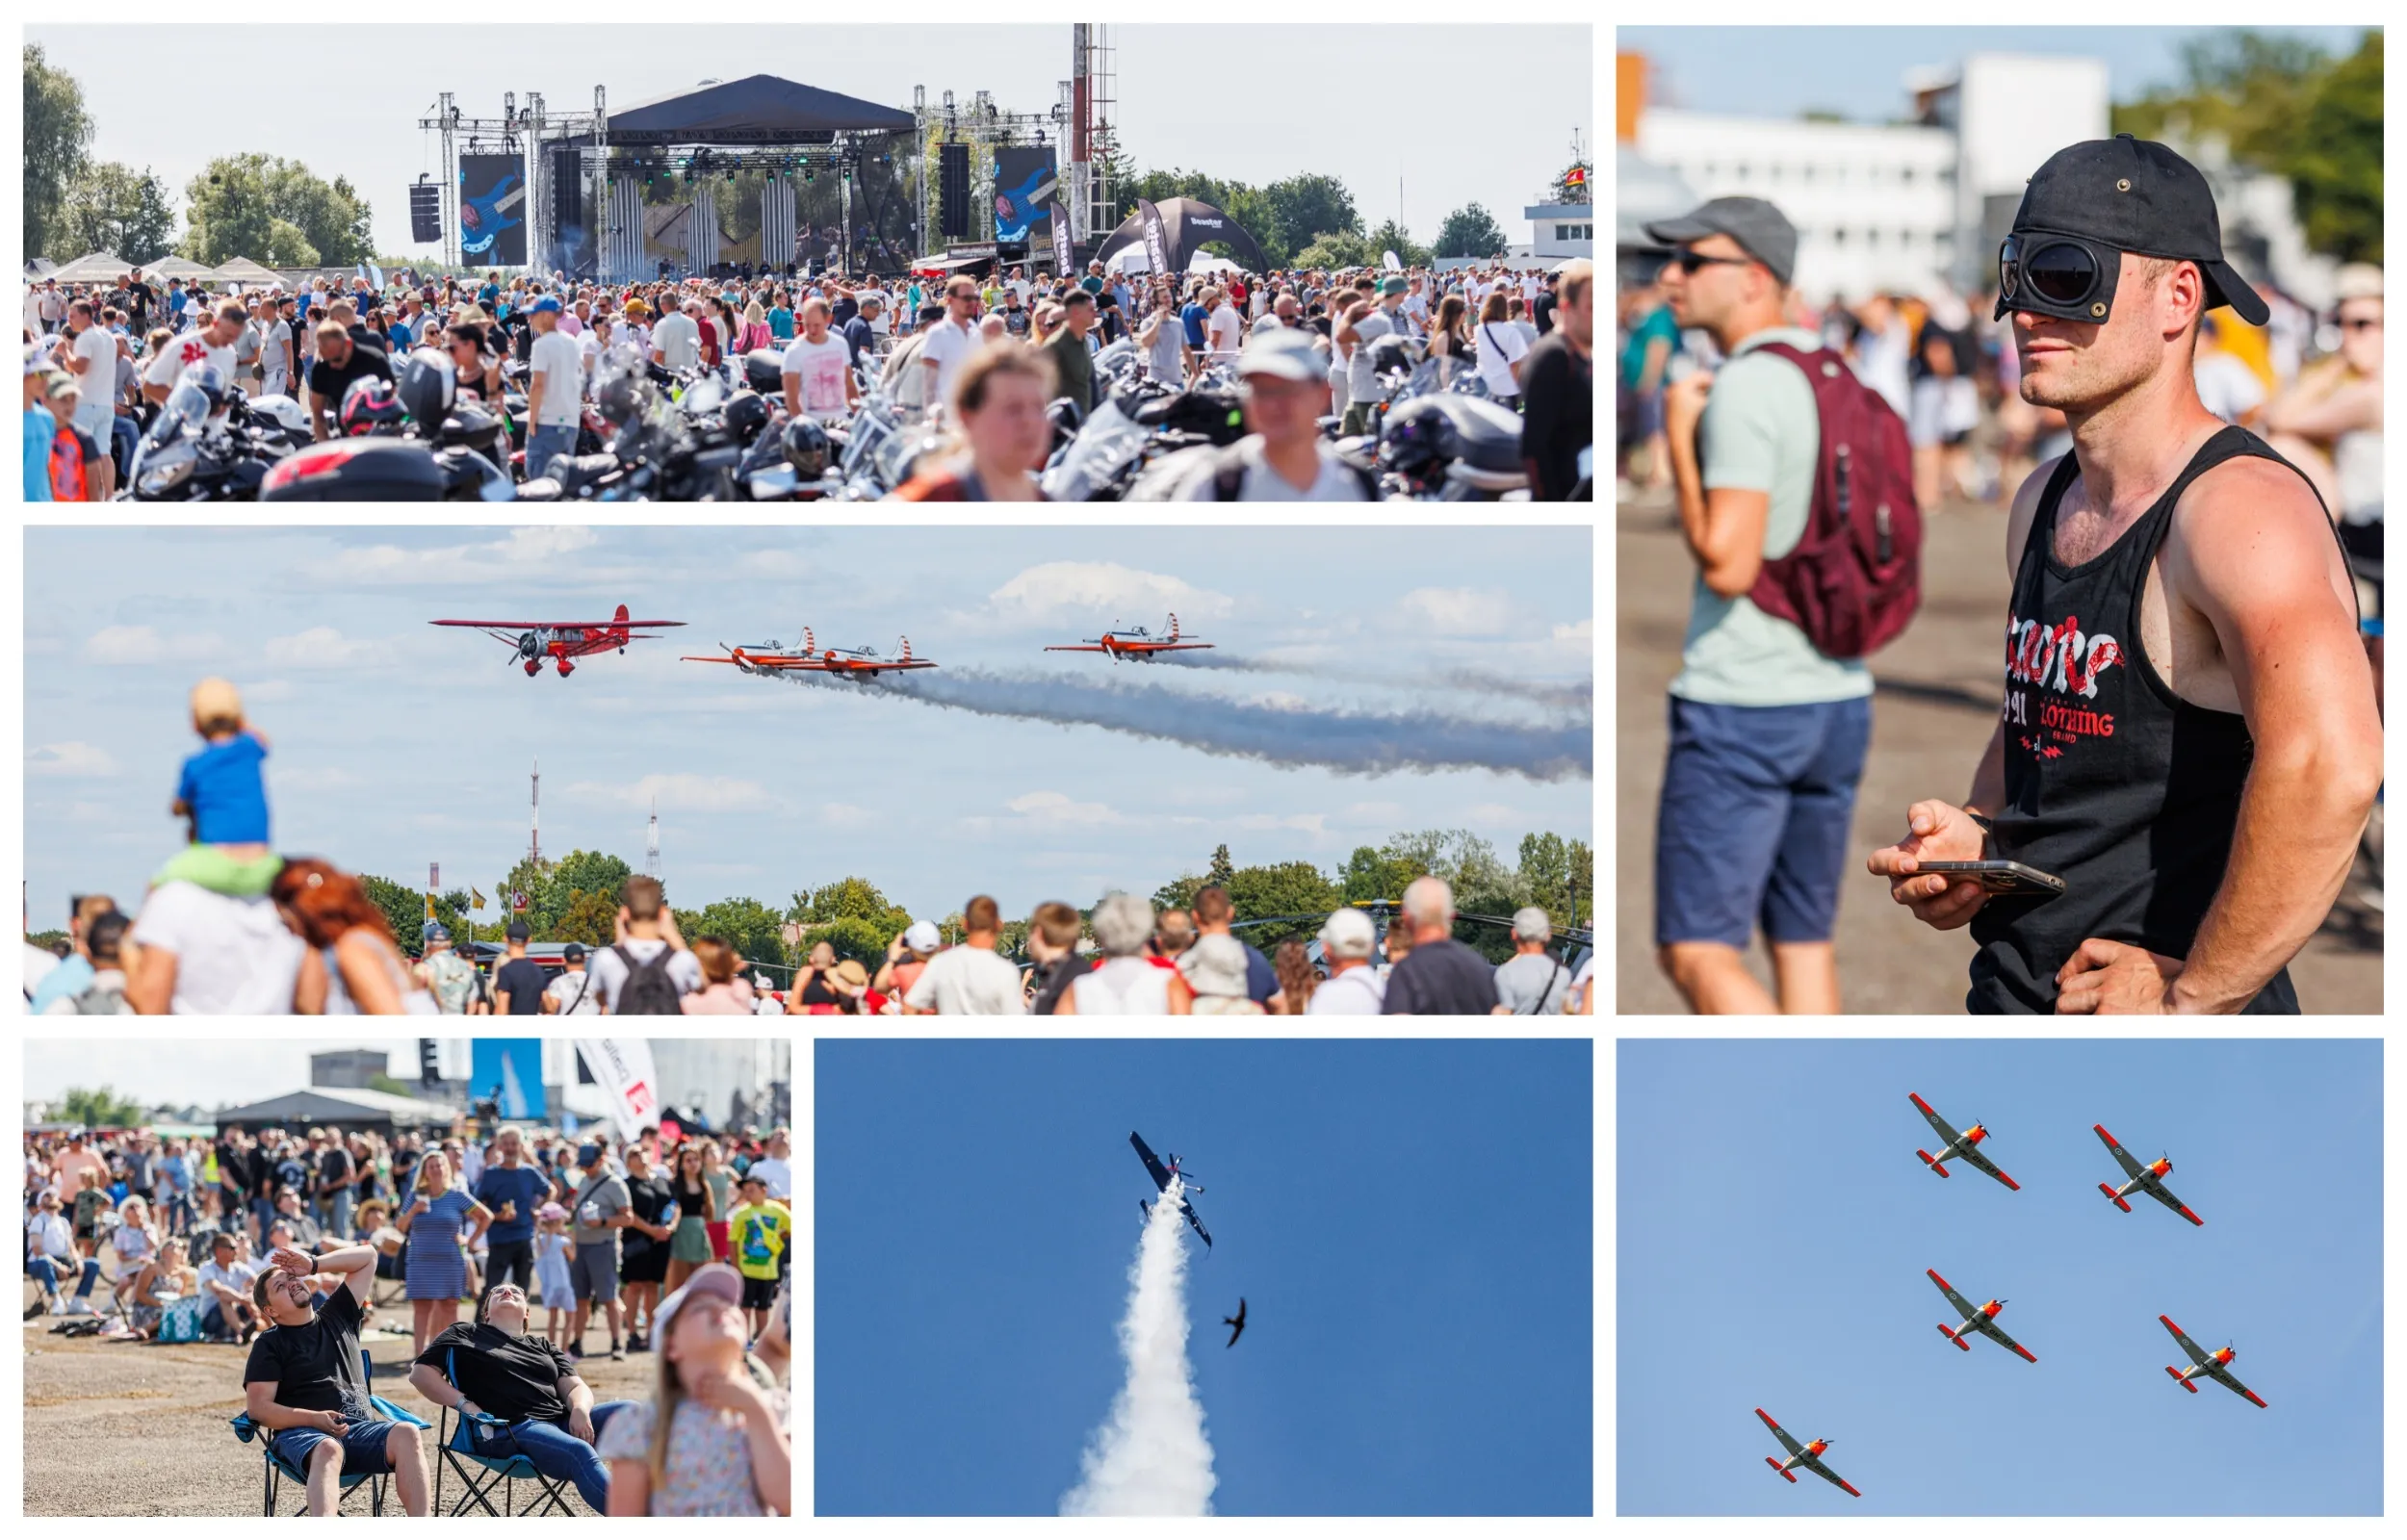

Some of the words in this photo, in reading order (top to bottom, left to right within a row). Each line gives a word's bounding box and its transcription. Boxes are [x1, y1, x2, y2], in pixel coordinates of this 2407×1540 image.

[1190, 217, 1223, 225] Beaster
[1058, 219, 1071, 277] Beaster
[2052, 731, 2077, 744] BRAND
